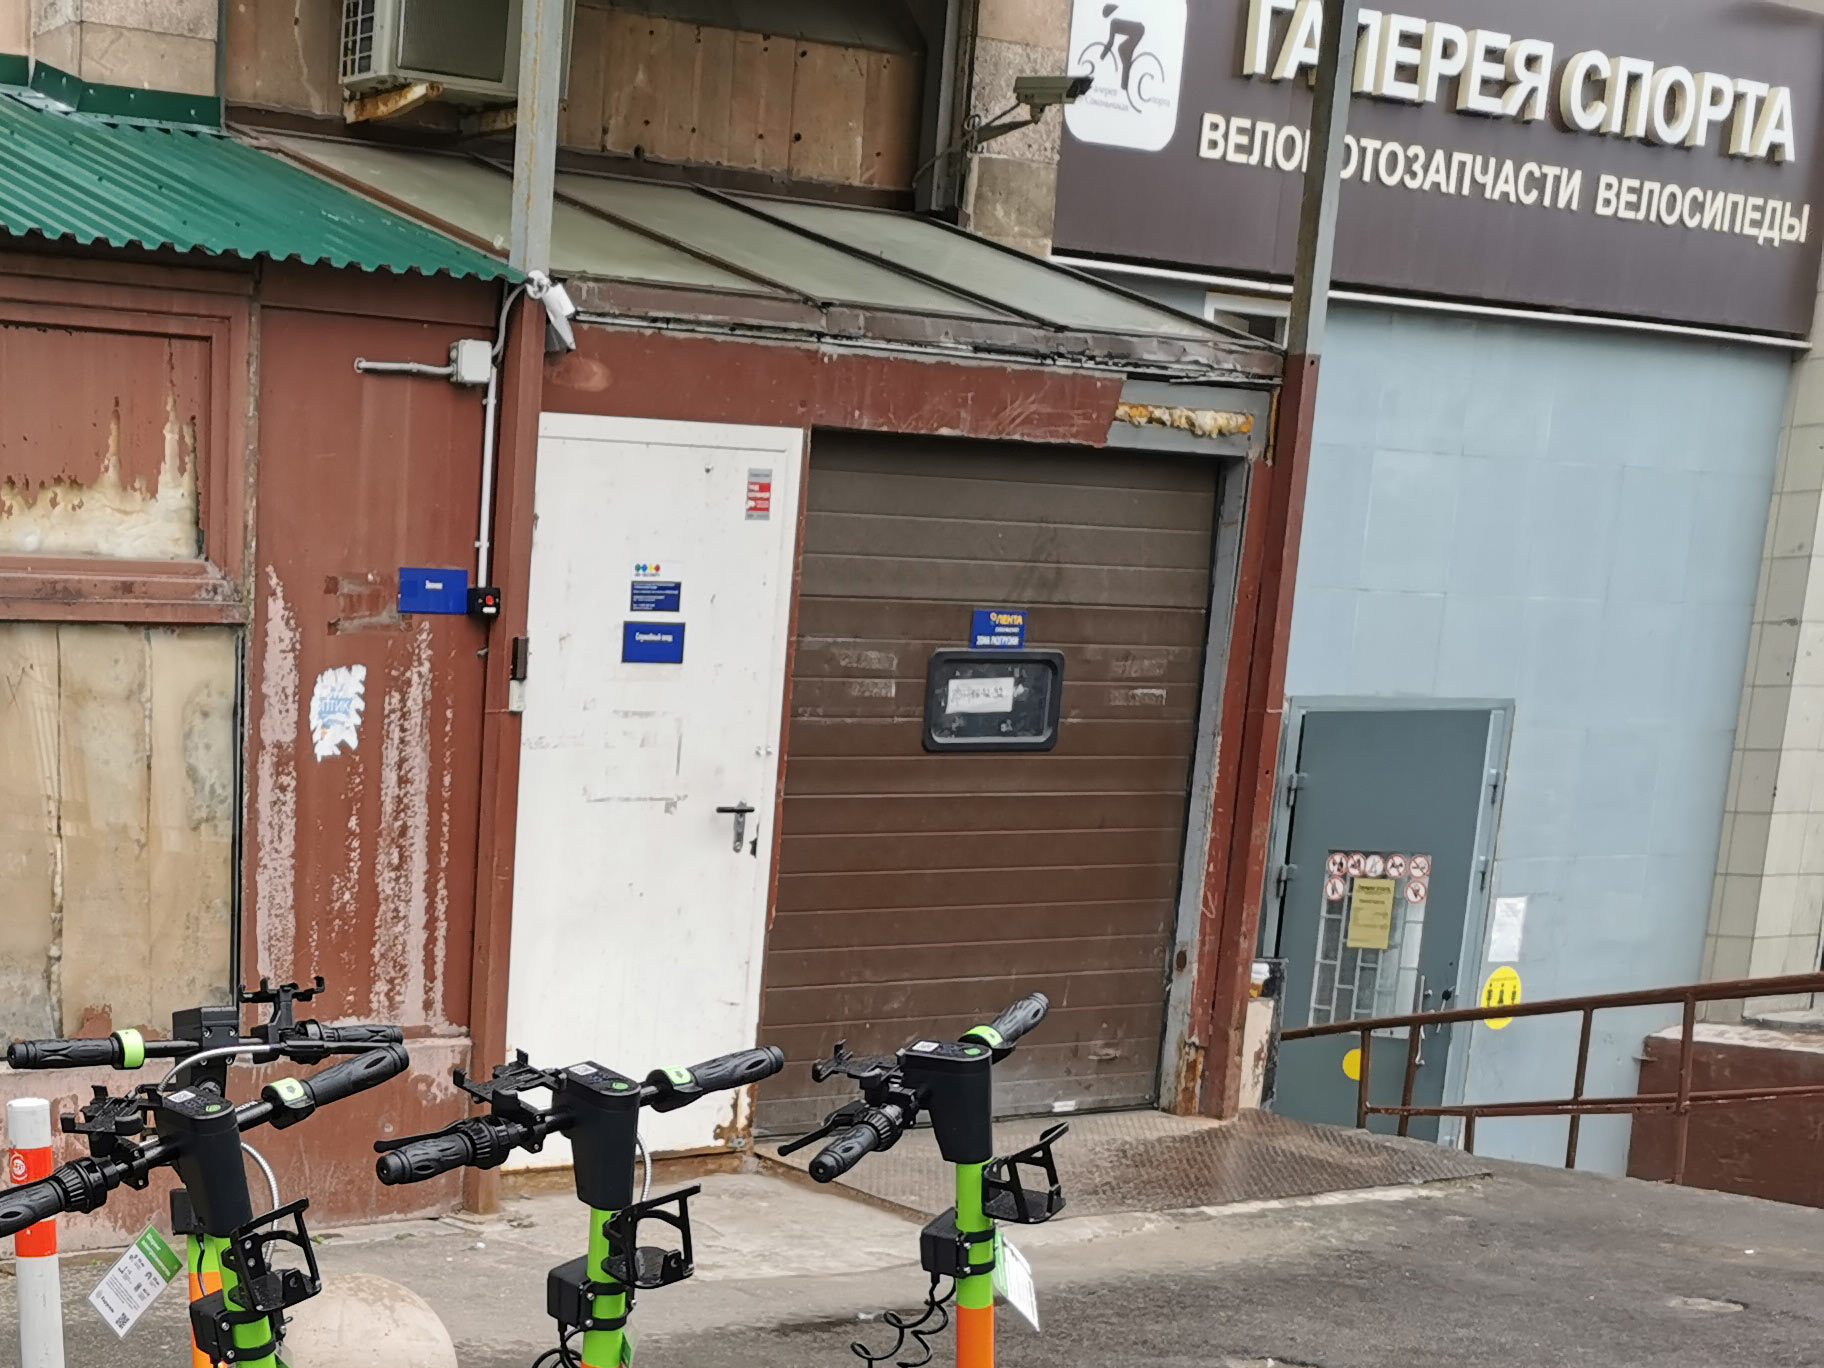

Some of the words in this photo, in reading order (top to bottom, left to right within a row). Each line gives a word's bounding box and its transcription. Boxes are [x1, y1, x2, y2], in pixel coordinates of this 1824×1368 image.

[1561, 50, 1795, 162] СПОРТА
[1199, 113, 1582, 212] ВЕЛООТОЗАПЧАСТИ
[1595, 174, 1810, 247] ВЕЛОСИПЕДЫ
